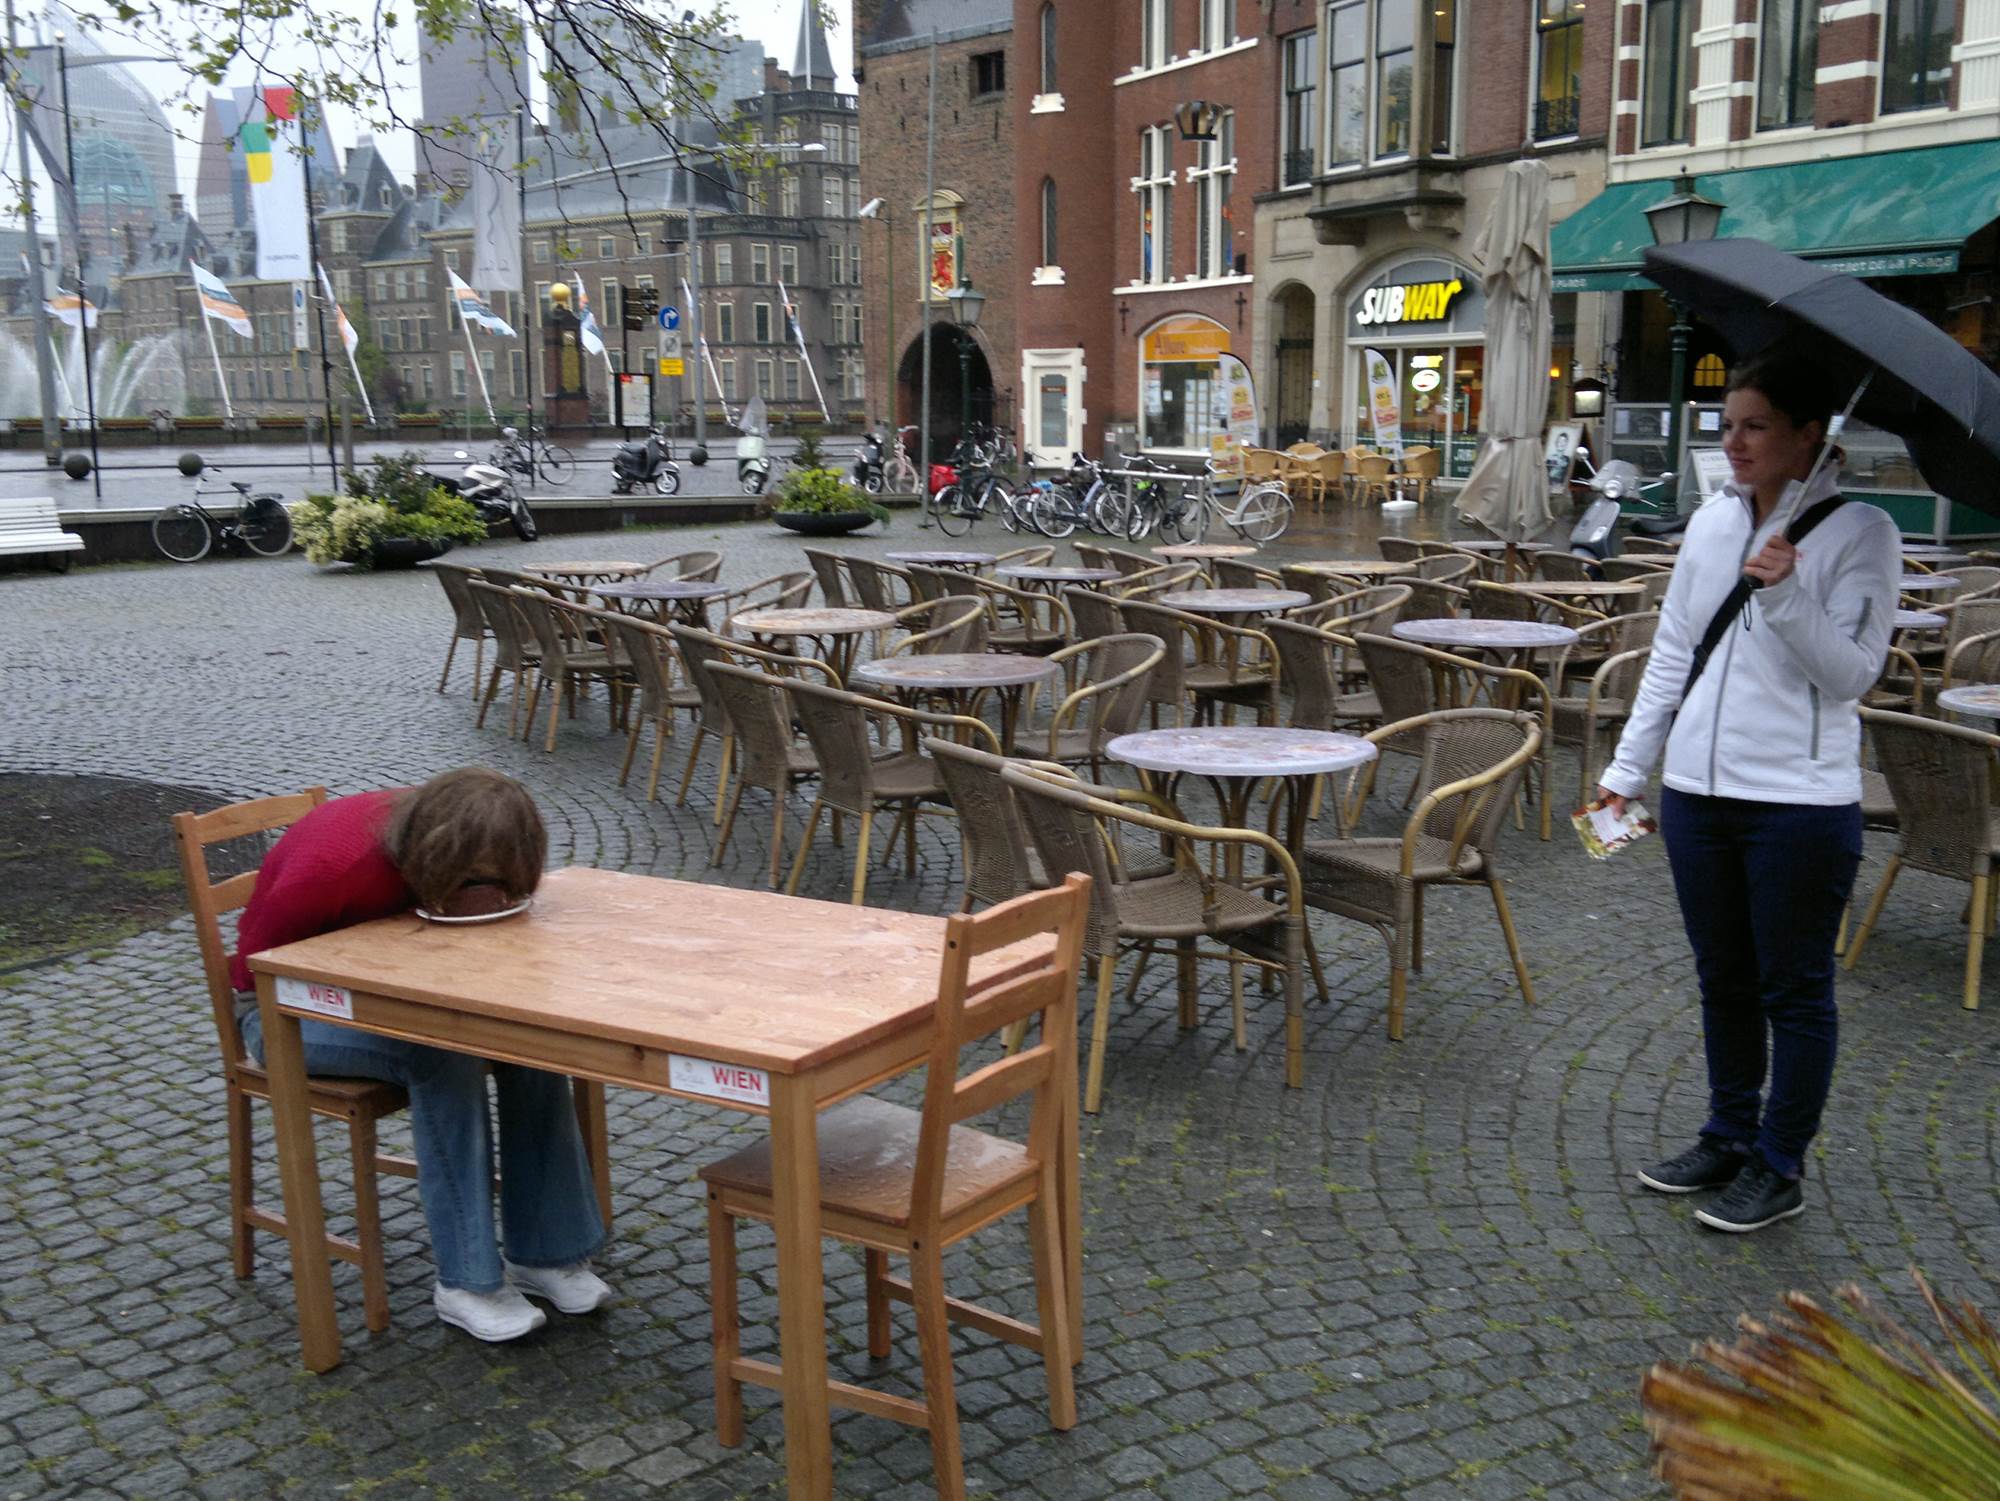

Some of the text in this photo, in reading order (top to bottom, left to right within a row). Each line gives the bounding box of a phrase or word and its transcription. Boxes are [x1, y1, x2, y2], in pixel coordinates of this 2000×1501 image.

[1356, 278, 1463, 325] SUBWAY
[307, 983, 345, 1007] WIEN
[711, 1065, 762, 1092] WIEN
